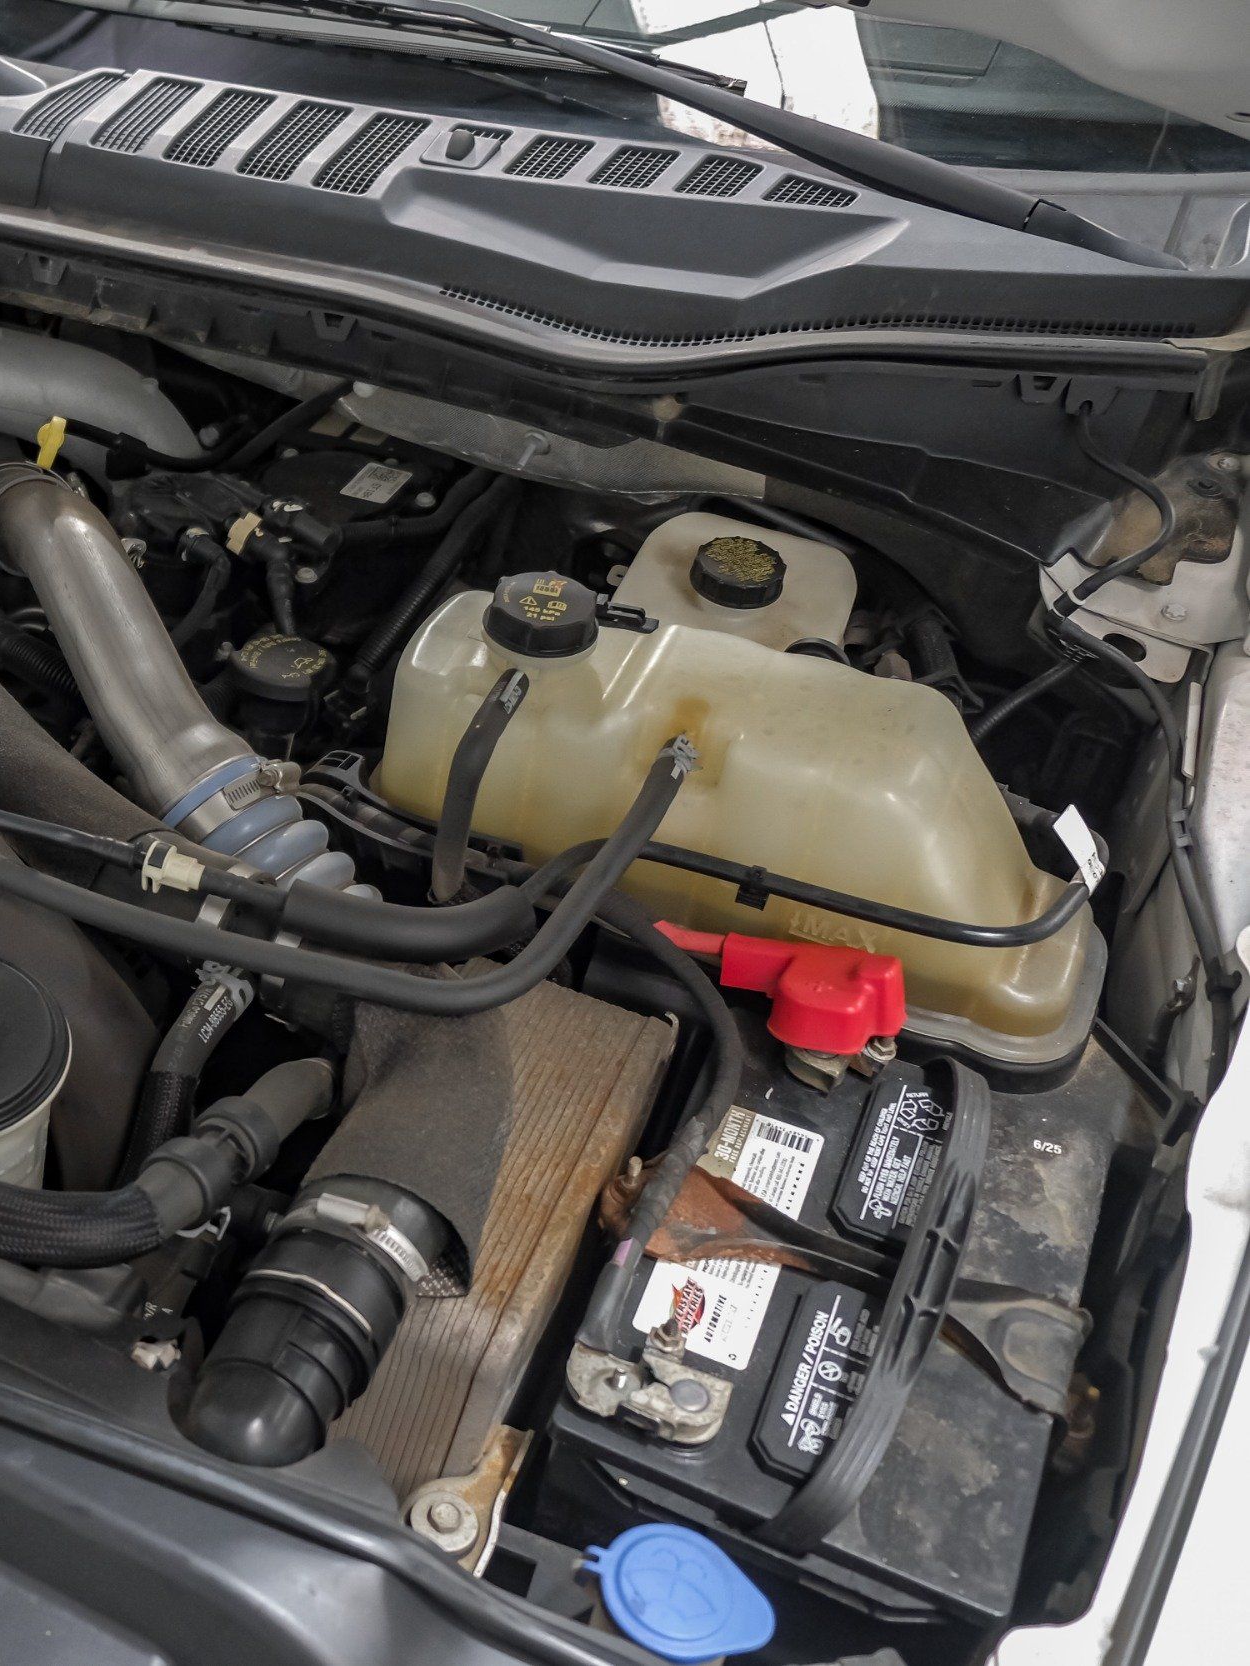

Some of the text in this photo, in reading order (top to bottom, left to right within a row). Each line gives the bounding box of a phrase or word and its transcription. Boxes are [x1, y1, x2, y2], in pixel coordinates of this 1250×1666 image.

[713, 1108, 746, 1161] 30-MONTH
[1033, 1139, 1062, 1155] 6/25
[702, 1293, 728, 1343] AUTOMOTIVE
[785, 1361, 812, 1412] DANGER
[803, 1308, 830, 1354] POISON
